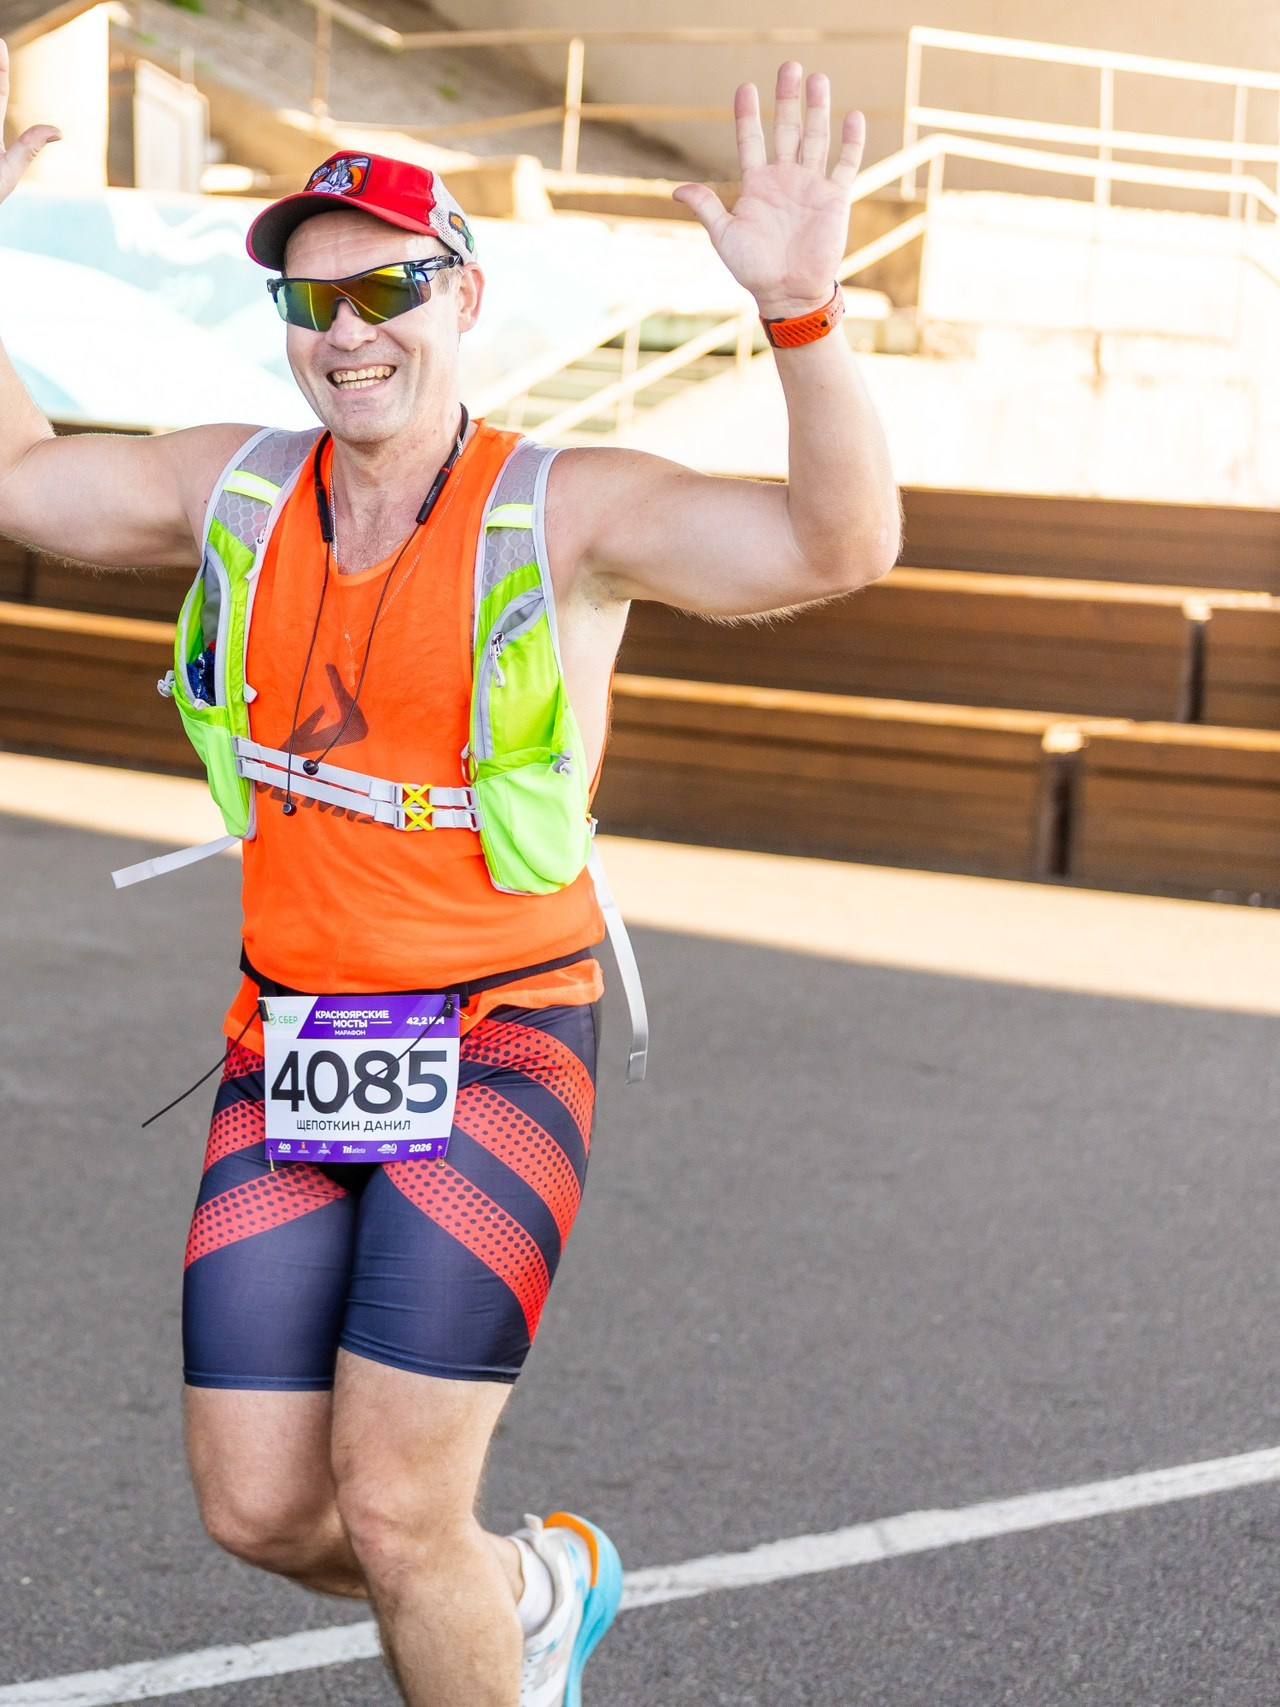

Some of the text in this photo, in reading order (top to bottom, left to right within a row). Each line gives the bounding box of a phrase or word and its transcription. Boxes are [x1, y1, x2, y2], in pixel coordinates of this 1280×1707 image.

[278, 1015, 299, 1024] СБЕР
[315, 1010, 390, 1019] КРАСНОЯРСКИЕ
[333, 1019, 368, 1028] МОСТЫ
[406, 1016, 428, 1026] 42,2
[271, 1050, 448, 1114] 4085
[296, 1120, 411, 1132] ЩЕПОТКИН ДАНИЛ
[408, 1143, 432, 1153] 2026
